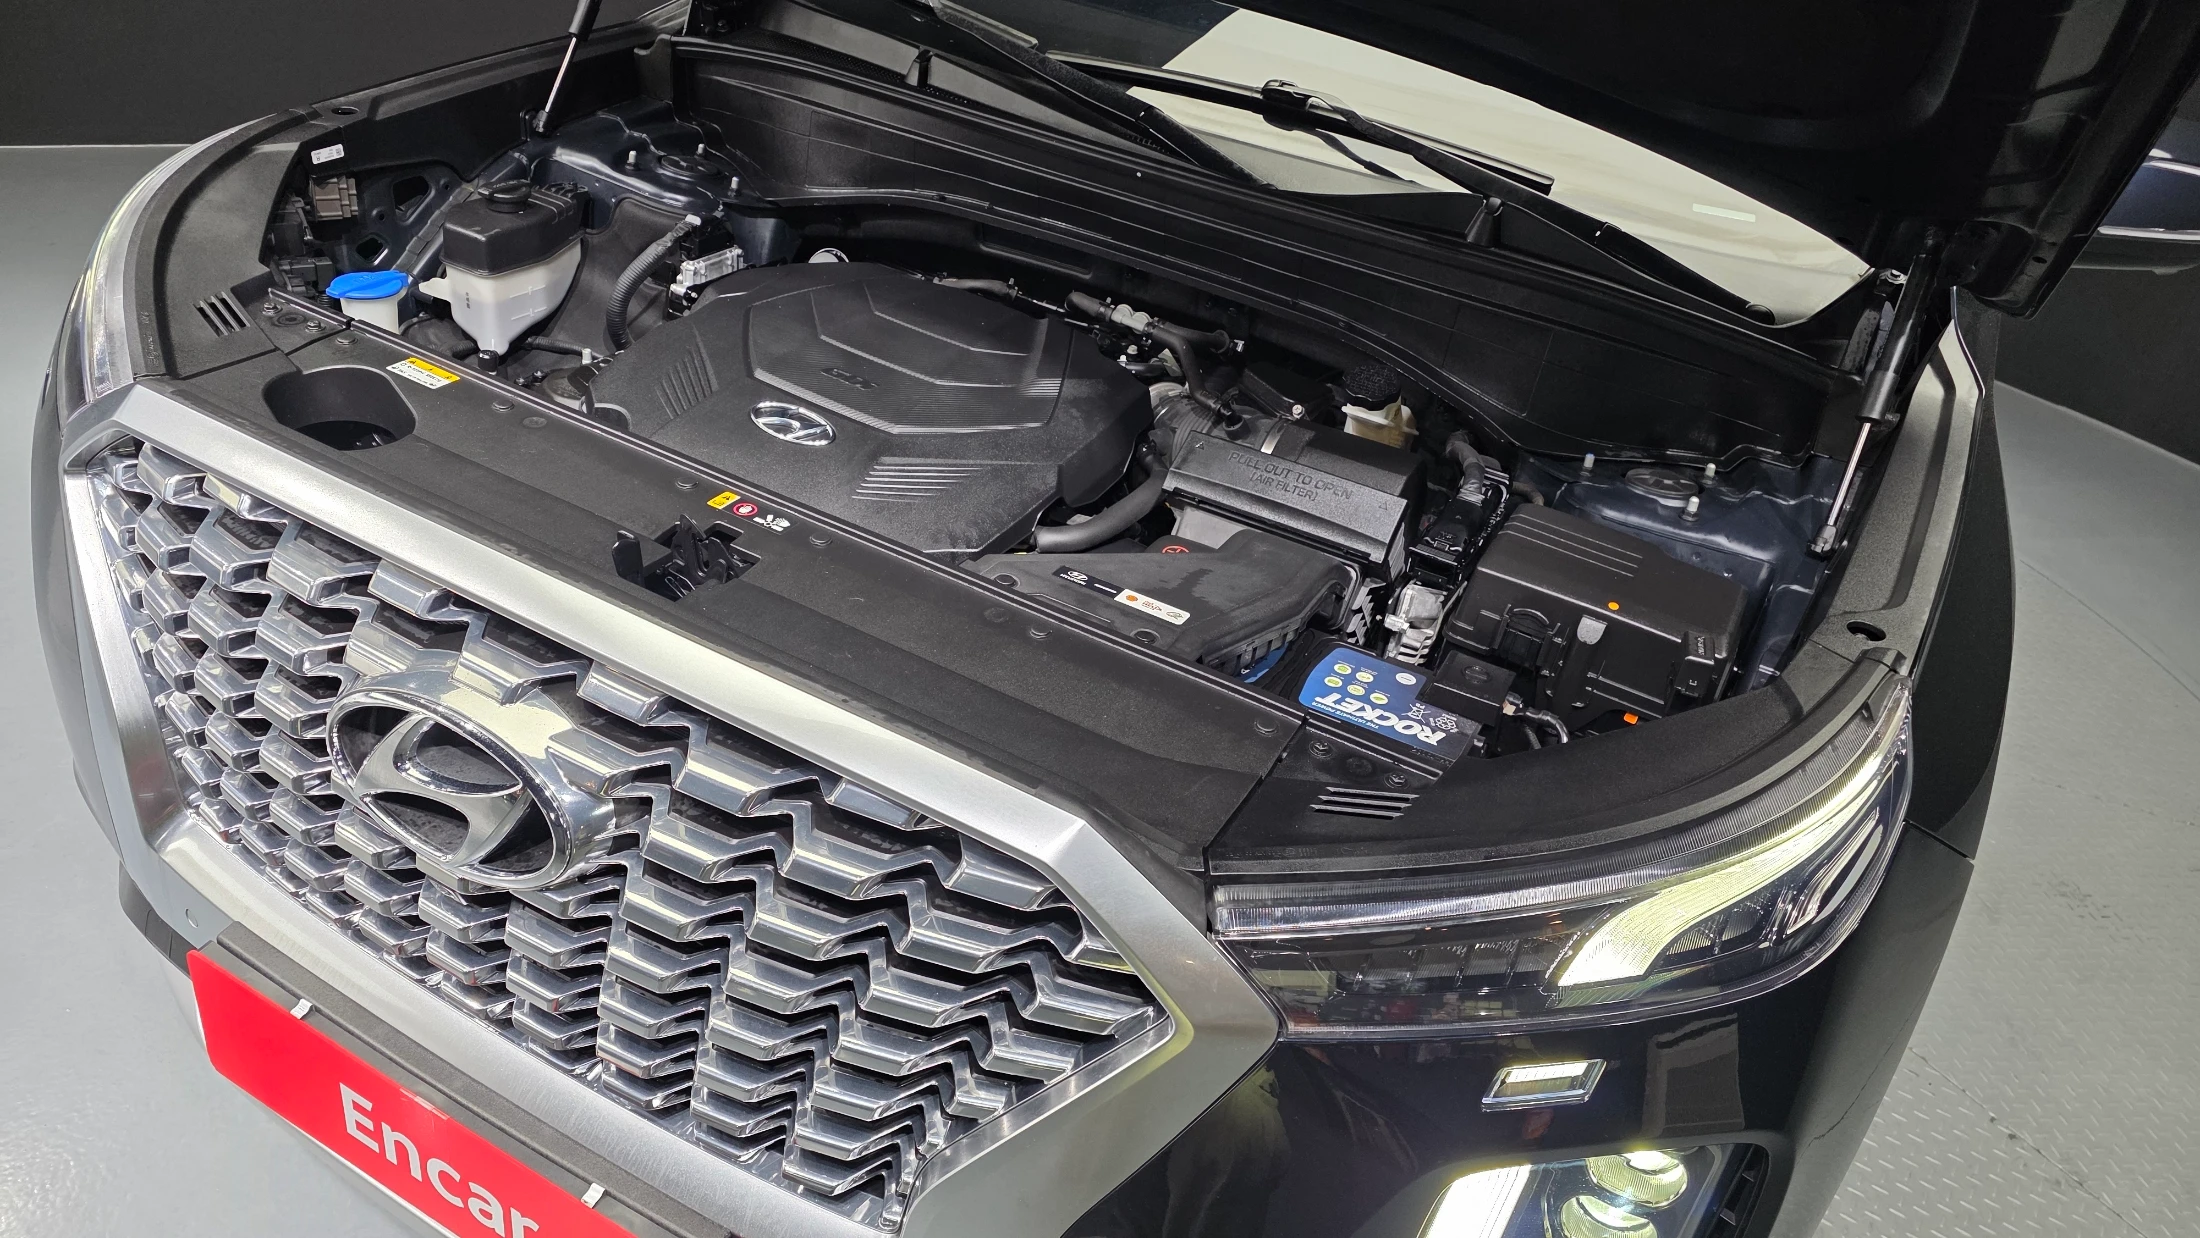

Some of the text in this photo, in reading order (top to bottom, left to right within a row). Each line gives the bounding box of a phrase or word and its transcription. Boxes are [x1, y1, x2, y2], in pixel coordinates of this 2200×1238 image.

[1228, 451, 1354, 500] PULL OUT TO OPEN
[1249, 471, 1318, 502] (AIR FILTER)
[1314, 692, 1447, 746] ROCKET
[1366, 721, 1379, 730] THE
[339, 1081, 540, 1238] Encar
